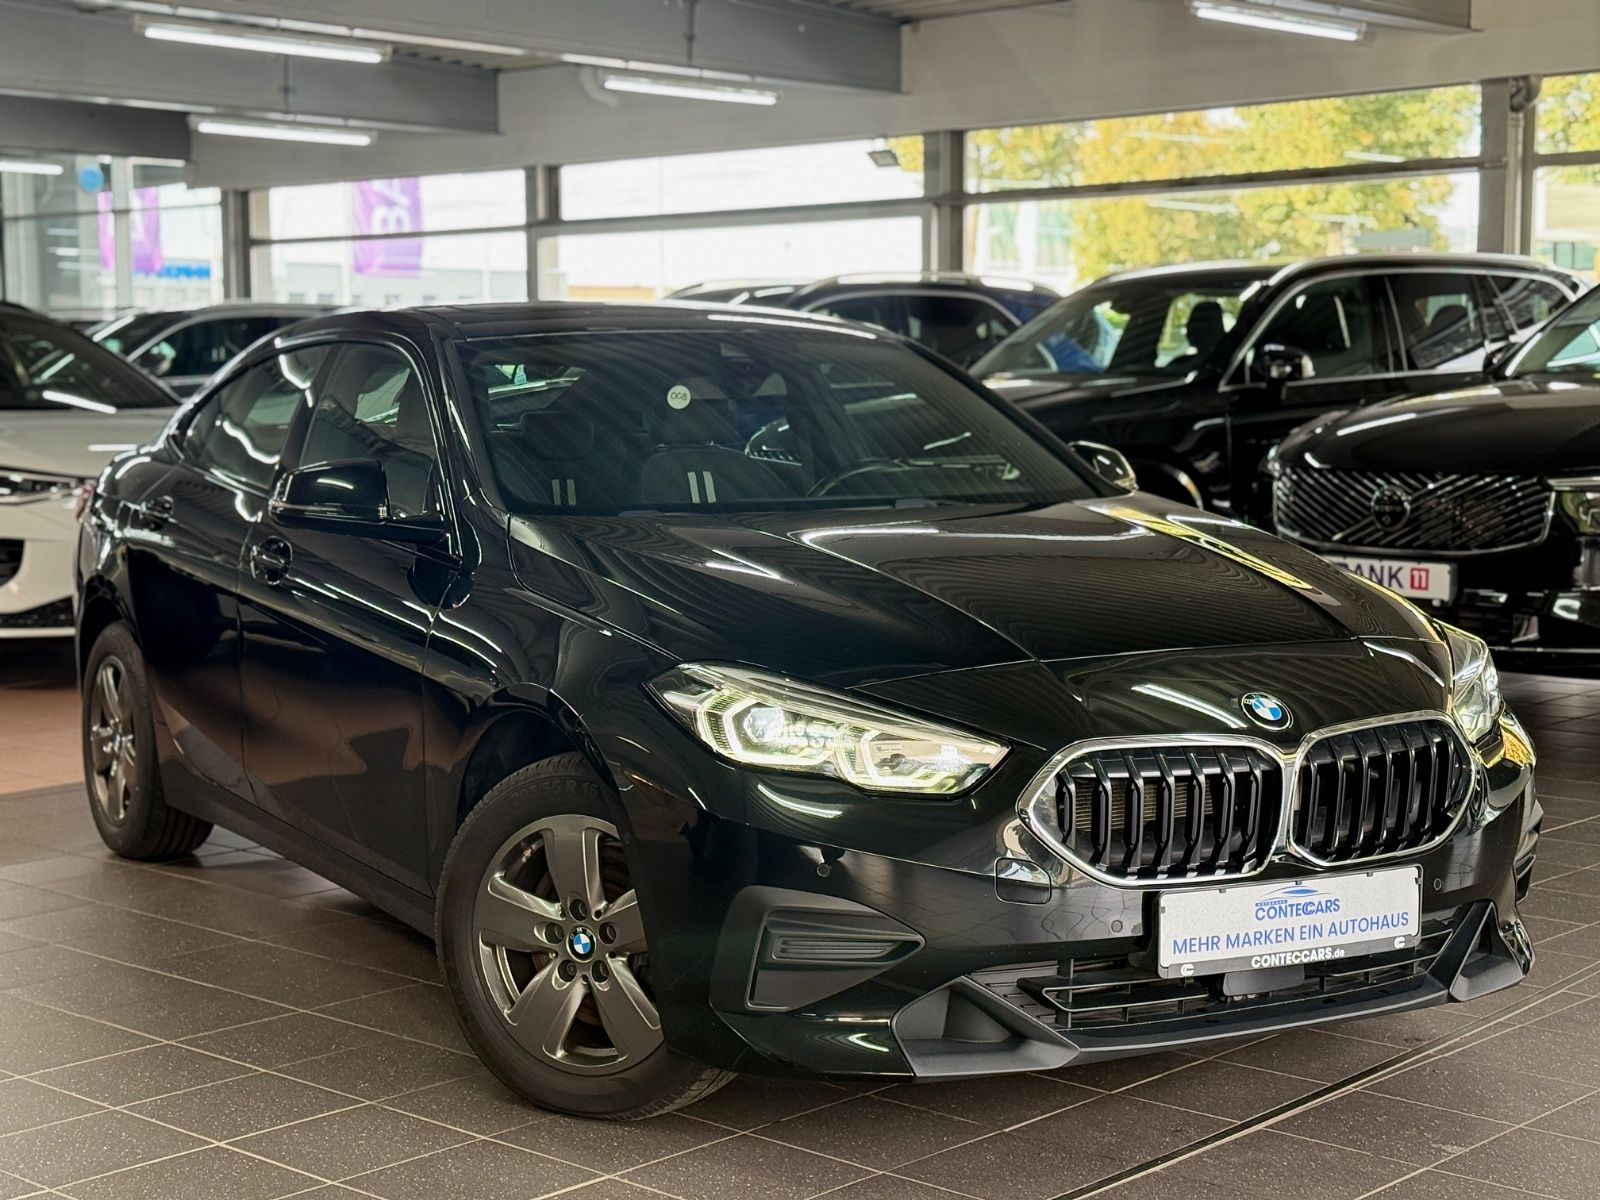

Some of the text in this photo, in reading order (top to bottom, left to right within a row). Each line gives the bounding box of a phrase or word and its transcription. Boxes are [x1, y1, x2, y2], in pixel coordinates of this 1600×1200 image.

[1254, 898, 1340, 921] CONTECCARS
[1172, 911, 1410, 954] MEHR MARKEN EIN AUTOHAUS
[1250, 946, 1346, 969] CONTECCARS.de
